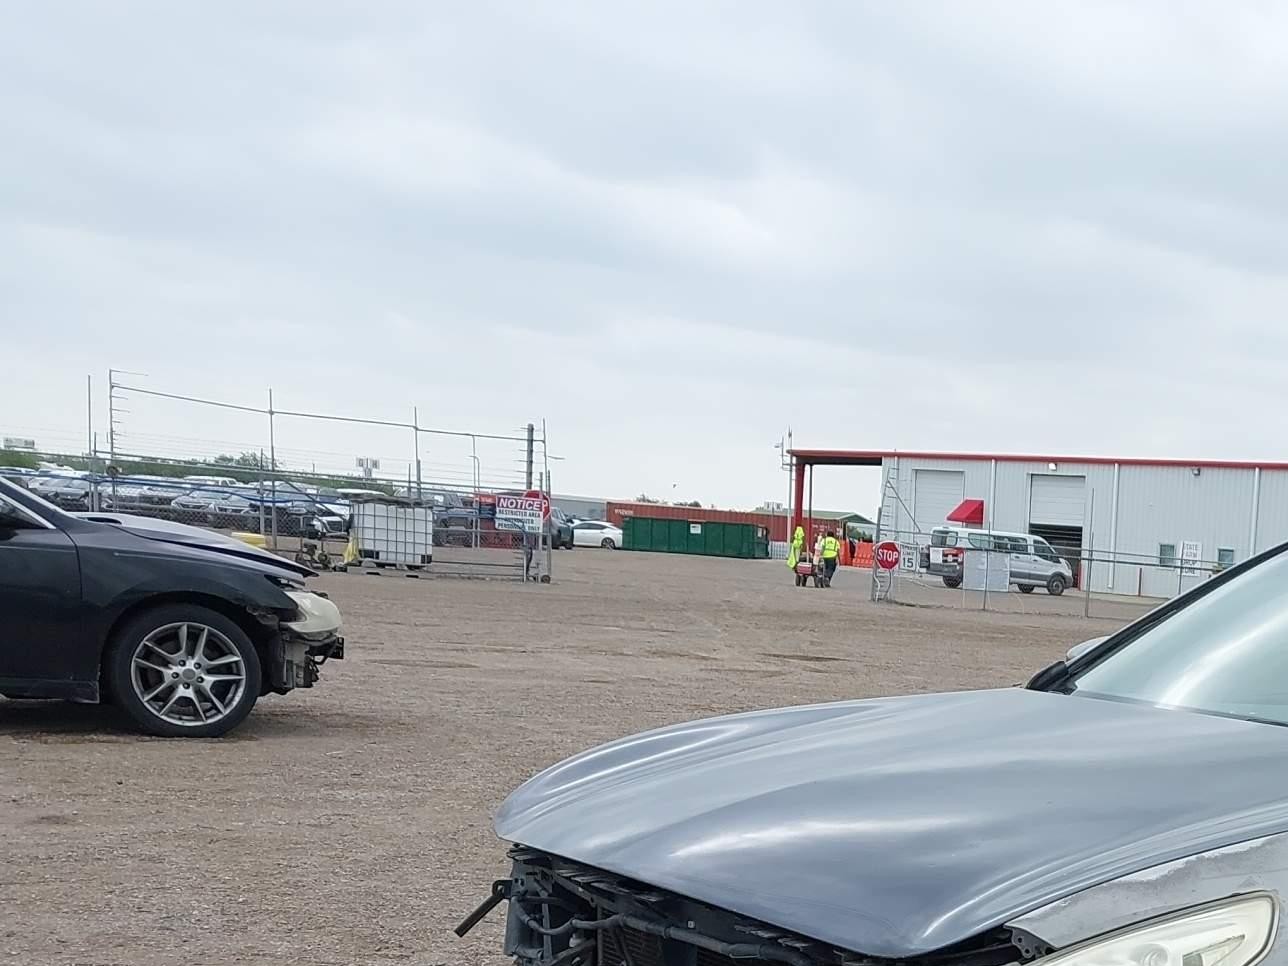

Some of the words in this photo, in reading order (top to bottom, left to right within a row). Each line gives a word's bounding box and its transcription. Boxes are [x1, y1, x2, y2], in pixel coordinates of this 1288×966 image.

[850, 281, 861, 293] 4
[499, 498, 542, 511] NOTICE
[498, 509, 527, 517] RESTRICTED
[878, 549, 899, 562] STOP
[903, 557, 914, 568] 15
